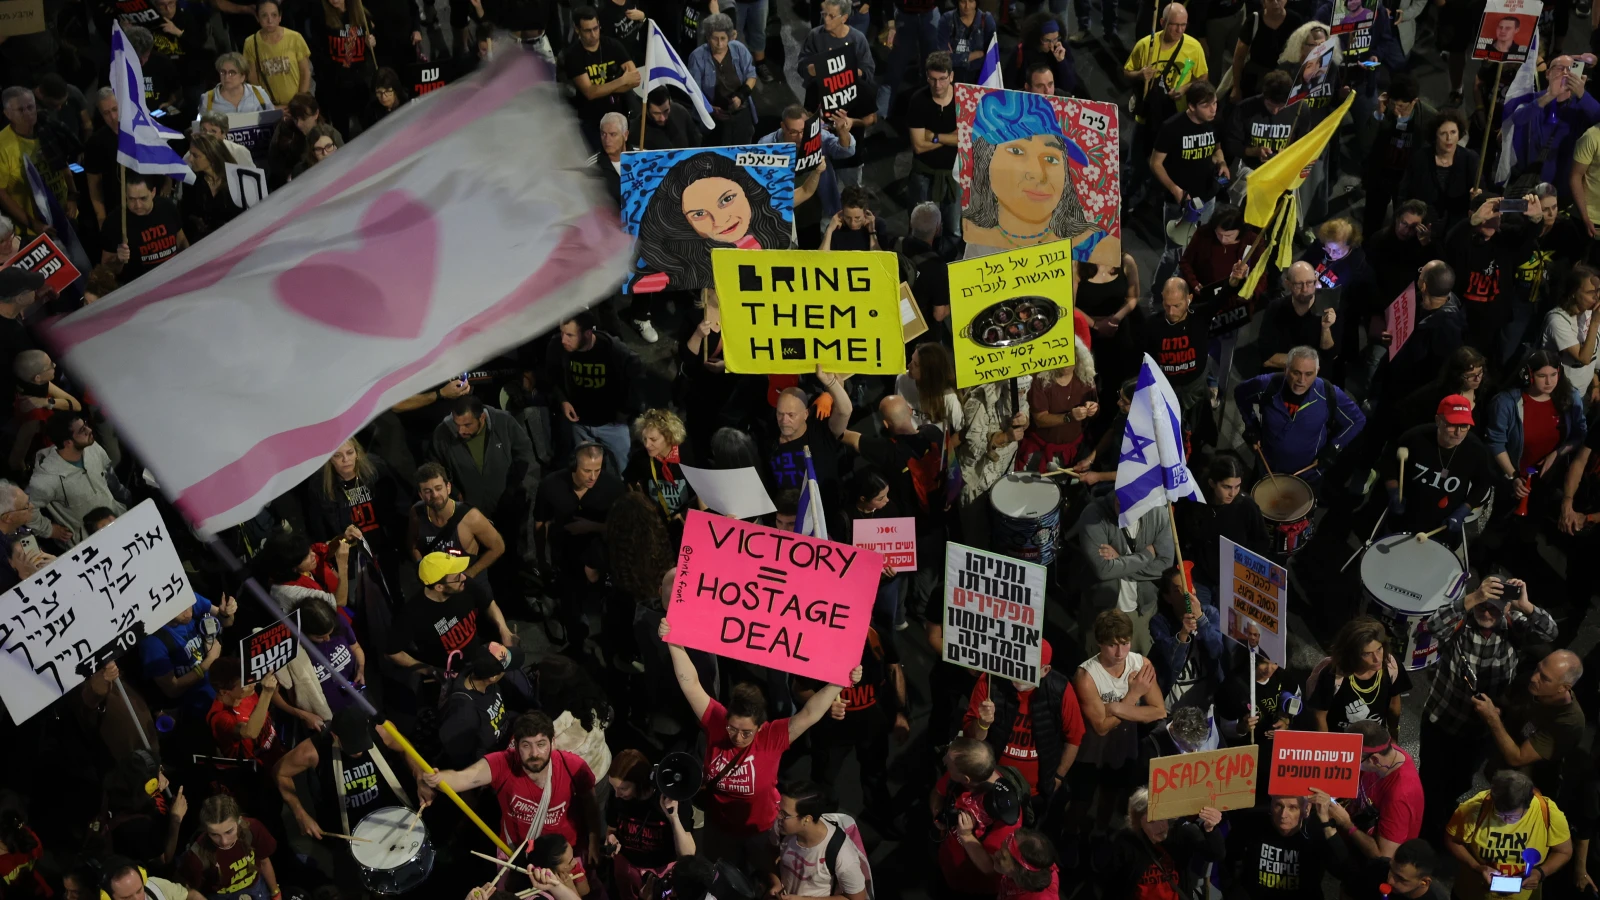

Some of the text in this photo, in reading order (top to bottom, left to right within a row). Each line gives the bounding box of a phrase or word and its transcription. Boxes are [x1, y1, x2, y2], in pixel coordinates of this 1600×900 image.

[421, 68, 440, 83] עם
[827, 54, 846, 75] עם
[823, 69, 855, 94] חטוף
[823, 84, 857, 110] בארצו
[810, 117, 820, 138] עם
[1082, 113, 1106, 131] לירי
[1182, 131, 1216, 149] בלעדיהם
[739, 153, 788, 166] דניאלה
[141, 223, 168, 243] כולנו
[31, 243, 51, 263] את
[139, 234, 177, 256] חטופים
[976, 260, 1005, 283] מלך
[1008, 256, 1029, 271] של
[738, 264, 871, 292] BRING
[1012, 268, 1066, 290] מוגשות
[741, 302, 856, 330] THEM
[750, 337, 882, 368] HOME!
[1010, 344, 1035, 358] 407
[1042, 337, 1069, 350] כבר
[1162, 335, 1190, 351] כולנו
[975, 354, 1070, 381] ממשלת ישראל
[988, 350, 1005, 364] יום
[1412, 462, 1461, 493] 7.10
[707, 520, 858, 579] VICTORY
[895, 541, 914, 551] נשים
[889, 555, 913, 566] עסקה
[965, 552, 1026, 585] נתניהו
[149, 573, 185, 612] לכל
[958, 569, 1032, 606] וחבורתו
[696, 572, 851, 630] HOSTAGE
[953, 587, 1035, 626] מפקירים
[948, 606, 1040, 648] את ביטחון
[720, 616, 810, 662] DEAL
[958, 628, 1027, 663] המדינה
[251, 638, 293, 671] העם
[947, 642, 1037, 684] והחטופים
[840, 683, 876, 706] OW!
[1010, 747, 1028, 757] שהם
[1279, 748, 1355, 763] עד שהם חוזרים
[352, 761, 375, 780] למה
[1152, 753, 1255, 794] DEAD END
[1277, 764, 1353, 780] כולנו חטופים
[1488, 832, 1528, 850] אתה
[1261, 842, 1300, 864] GET MY
[1259, 857, 1300, 876] PEOPLE
[1258, 870, 1300, 890] HOME!
